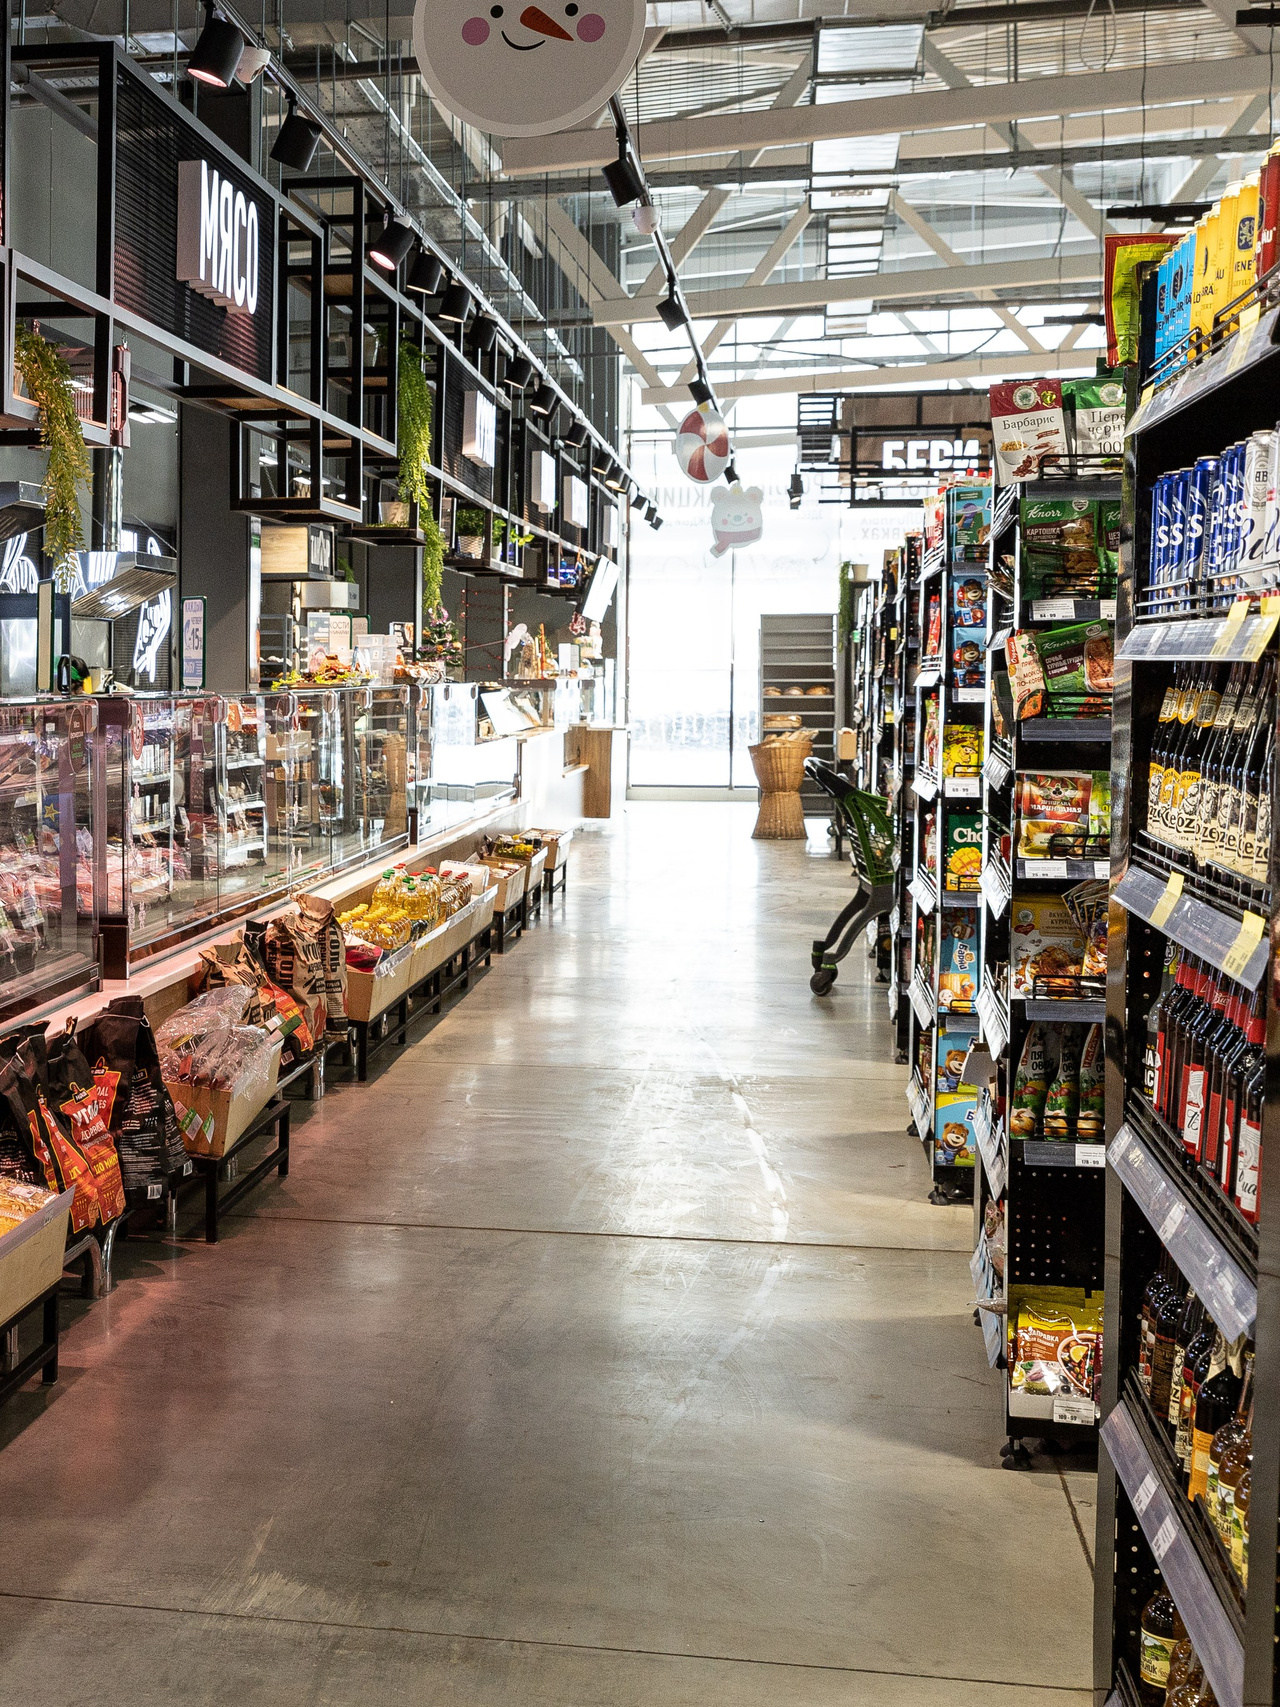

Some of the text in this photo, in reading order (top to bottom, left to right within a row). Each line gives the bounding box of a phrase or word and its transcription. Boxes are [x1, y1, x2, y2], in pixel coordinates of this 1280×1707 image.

[199, 159, 260, 315] МЯСО
[1002, 415, 1055, 430] Барбарис
[1091, 411, 1126, 424] Пере
[1098, 441, 1122, 454] 100
[1026, 503, 1063, 518] Knorr
[1026, 527, 1060, 536] КАРТОШКА
[955, 943, 968, 972] Барни
[1028, 1328, 1060, 1343] ЗАПРАВКА
